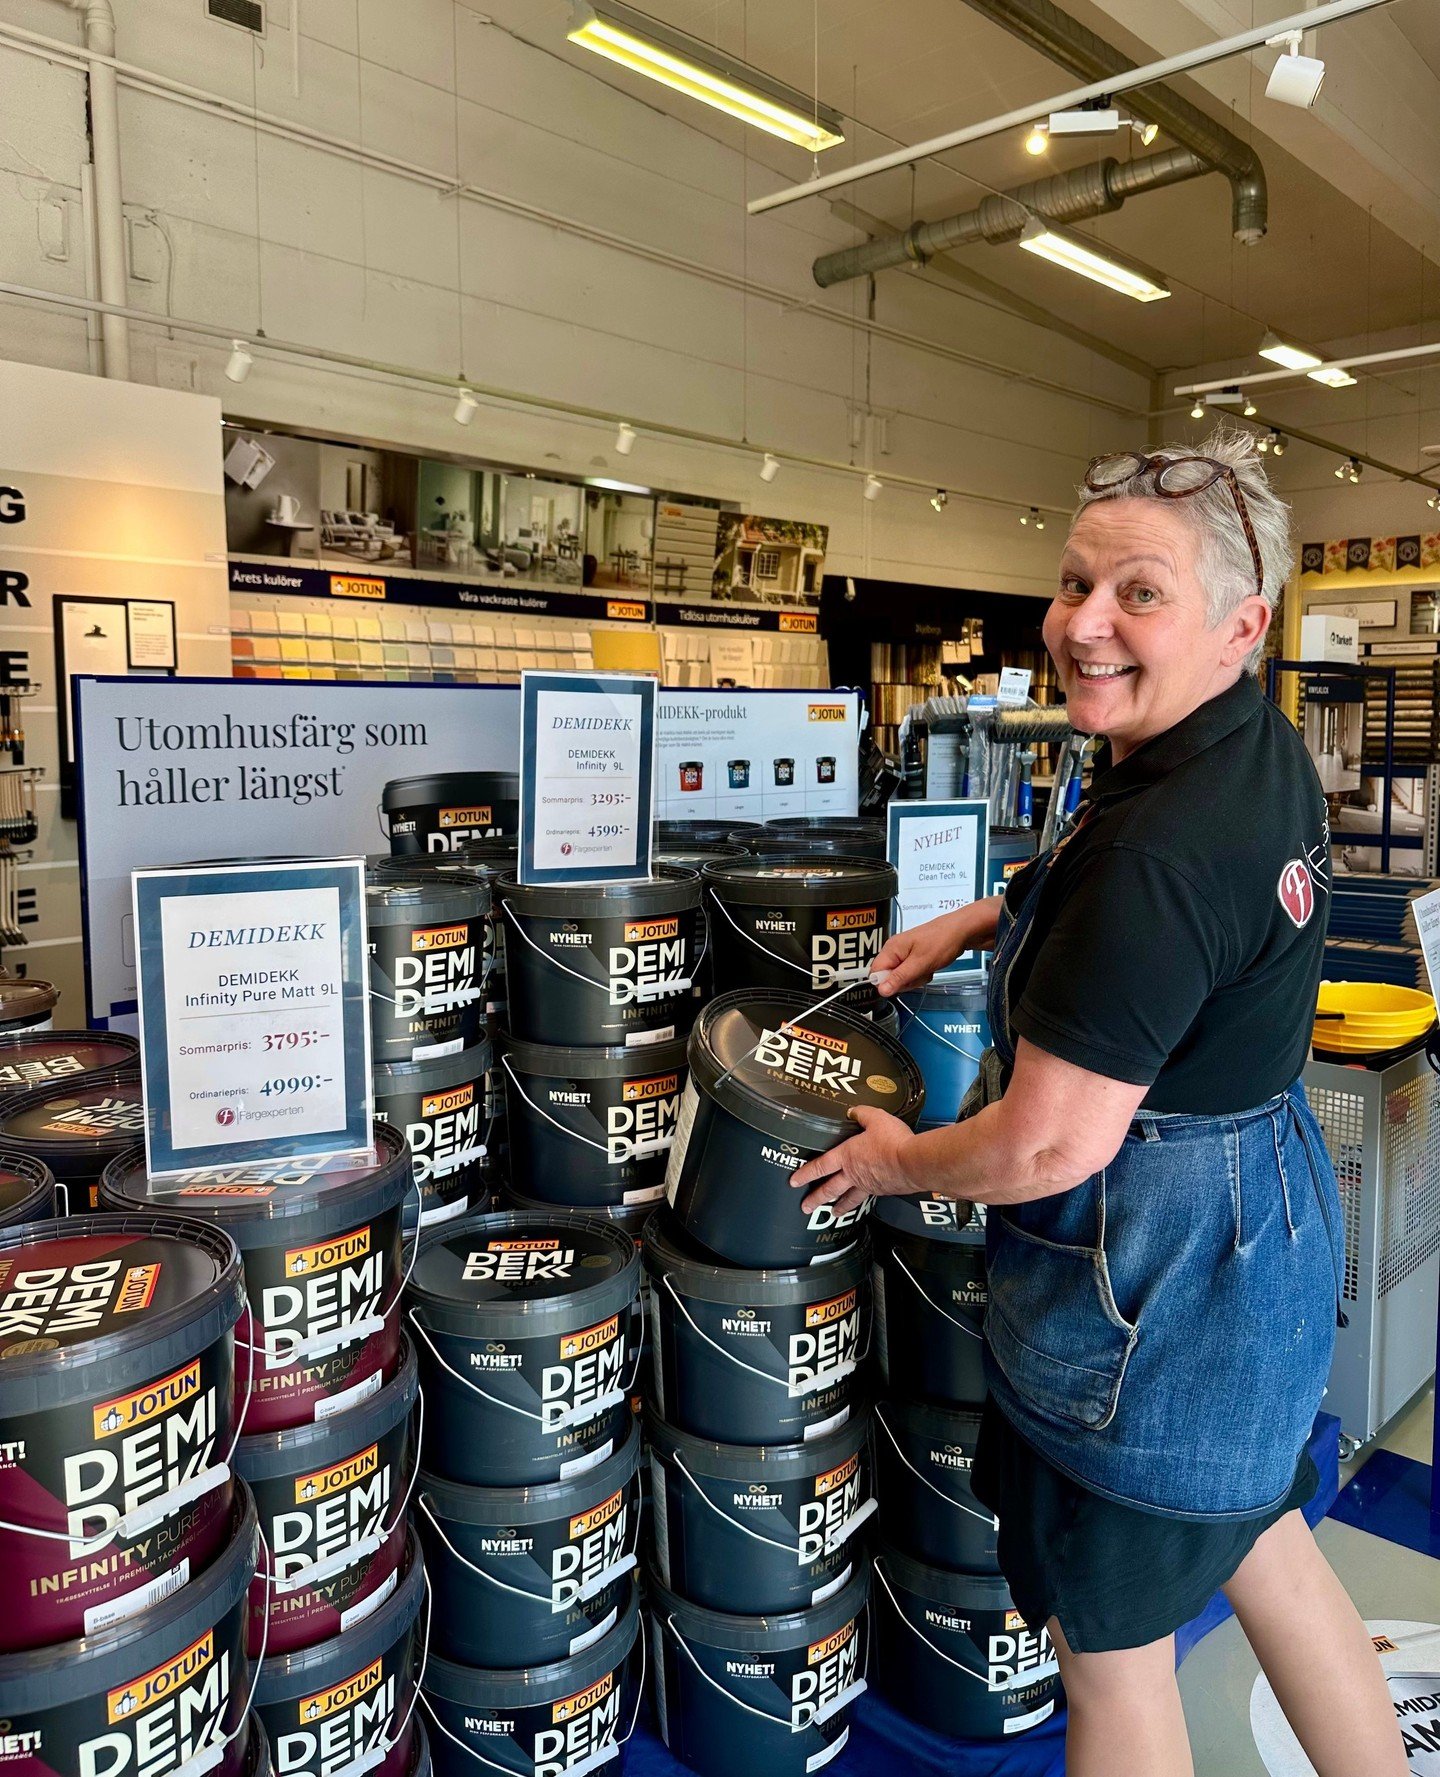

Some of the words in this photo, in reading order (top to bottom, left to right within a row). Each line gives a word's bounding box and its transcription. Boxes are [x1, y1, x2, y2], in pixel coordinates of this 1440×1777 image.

[232, 569, 263, 585] Årets
[263, 573, 303, 588] kulörer
[345, 582, 383, 596] JOTUN
[459, 591, 479, 603] Våra
[480, 594, 518, 607] vackraste
[519, 597, 548, 609] kulörer
[617, 606, 644, 617] JOTUN
[679, 610, 704, 623] Tidlösa
[789, 619, 815, 630] JOTUN
[1336, 633, 1353, 646] Tarkett
[552, 717, 633, 731] DEMIDEKK
[818, 708, 845, 720] JOTUN
[114, 713, 355, 754] Utomhusfärg
[365, 722, 428, 747] som
[568, 749, 616, 759] DEMIDEKK
[576, 761, 607, 772] Infinity
[613, 761, 624, 771] 9L
[117, 767, 230, 807] håller
[590, 792, 631, 806] 3295:-
[392, 820, 416, 834] NYHET!
[452, 810, 490, 825] JOTUN
[588, 824, 630, 837] 4599:-
[913, 825, 963, 852] NYHET
[918, 872, 938, 881] Clean
[940, 871, 955, 880] Tech
[959, 870, 967, 879] 9L
[919, 862, 956, 871] DEMIDEKK
[640, 922, 676, 939] JOTUN
[755, 920, 796, 932] NYHET!
[841, 911, 875, 927] JOTUN
[187, 922, 327, 949] DEMIDEKK
[429, 929, 466, 947] JOTUN
[549, 931, 593, 945] NYHET!
[811, 927, 883, 961] DEMI
[395, 946, 475, 987] DEMI
[609, 938, 686, 976] DEMI
[218, 969, 299, 988] DEMIDEKK
[185, 991, 238, 1007] Infinity
[243, 988, 277, 1003] Pure
[281, 985, 315, 999] Matt
[320, 983, 339, 996] 9L
[622, 1003, 676, 1019] INFINITY
[408, 1012, 465, 1034] INFINITY
[943, 1023, 981, 1034] NYHET!
[179, 1039, 252, 1057] Sommarpris:
[261, 1029, 330, 1053] 3795:-
[796, 1029, 846, 1052] JOTUN
[757, 1028, 862, 1078] DEMI
[754, 1045, 859, 1095] DEKK
[189, 1086, 249, 1101] Ordinariepris:
[259, 1073, 334, 1097] 4999:-
[639, 1078, 676, 1097] JOTUN
[766, 1067, 841, 1099] INFINITY
[438, 1088, 472, 1111] JOTUN
[549, 1090, 591, 1104] NYHET!
[406, 1103, 480, 1153] DEMI
[191, 1186, 253, 1195] JOTUN
[310, 1233, 367, 1268] JOTUN
[504, 1240, 558, 1250] JOTUN
[466, 1249, 574, 1266] DEMI
[461, 1264, 573, 1280] DEKK
[44, 1259, 122, 1334] DEMI
[120, 1277, 145, 1311] JOTUN
[263, 1251, 384, 1328] DEMI
[822, 1292, 856, 1321] JOTUN
[578, 1322, 617, 1351] JOTUN
[722, 1318, 771, 1333] NYHET!
[789, 1306, 860, 1365] DEMI
[330, 1349, 367, 1373] PURE
[470, 1353, 523, 1368] NYHET!
[541, 1333, 625, 1401] DEMI
[128, 1369, 198, 1423] JOTUN
[301, 1381, 332, 1394] PREMIUM
[556, 1413, 615, 1448] INFINITY
[64, 1385, 216, 1507] DEMI
[930, 1450, 974, 1469] NYHET
[320, 1451, 376, 1494] JOTUN
[829, 1455, 858, 1488] JOTUN
[272, 1463, 391, 1554] DEMI
[733, 1493, 783, 1506] NYHET!
[798, 1464, 861, 1535] DEMI
[586, 1494, 621, 1530] JOTUN
[481, 1538, 534, 1552] NYHET!
[552, 1503, 627, 1581] DEMI
[30, 1538, 152, 1597] INFINITY
[157, 1511, 201, 1550] PURE
[119, 1559, 157, 1583] PREMIUM
[339, 1559, 375, 1592] PURE
[310, 1598, 341, 1616] PREMIUM
[925, 1609, 972, 1632] NYHET!
[823, 1624, 855, 1656] JOTUN
[141, 1640, 210, 1704] JOTUN
[726, 1661, 775, 1675] NYHET!
[792, 1627, 859, 1704] DEMI
[324, 1665, 380, 1712] JOTUN
[571, 1677, 612, 1713] JOTUN
[1002, 1676, 1056, 1705] INFINITY
[79, 1649, 230, 1777] DEMI
[277, 1673, 396, 1773] DEMI
[464, 1716, 515, 1732] NYHET!
[534, 1684, 621, 1763] DEMI
